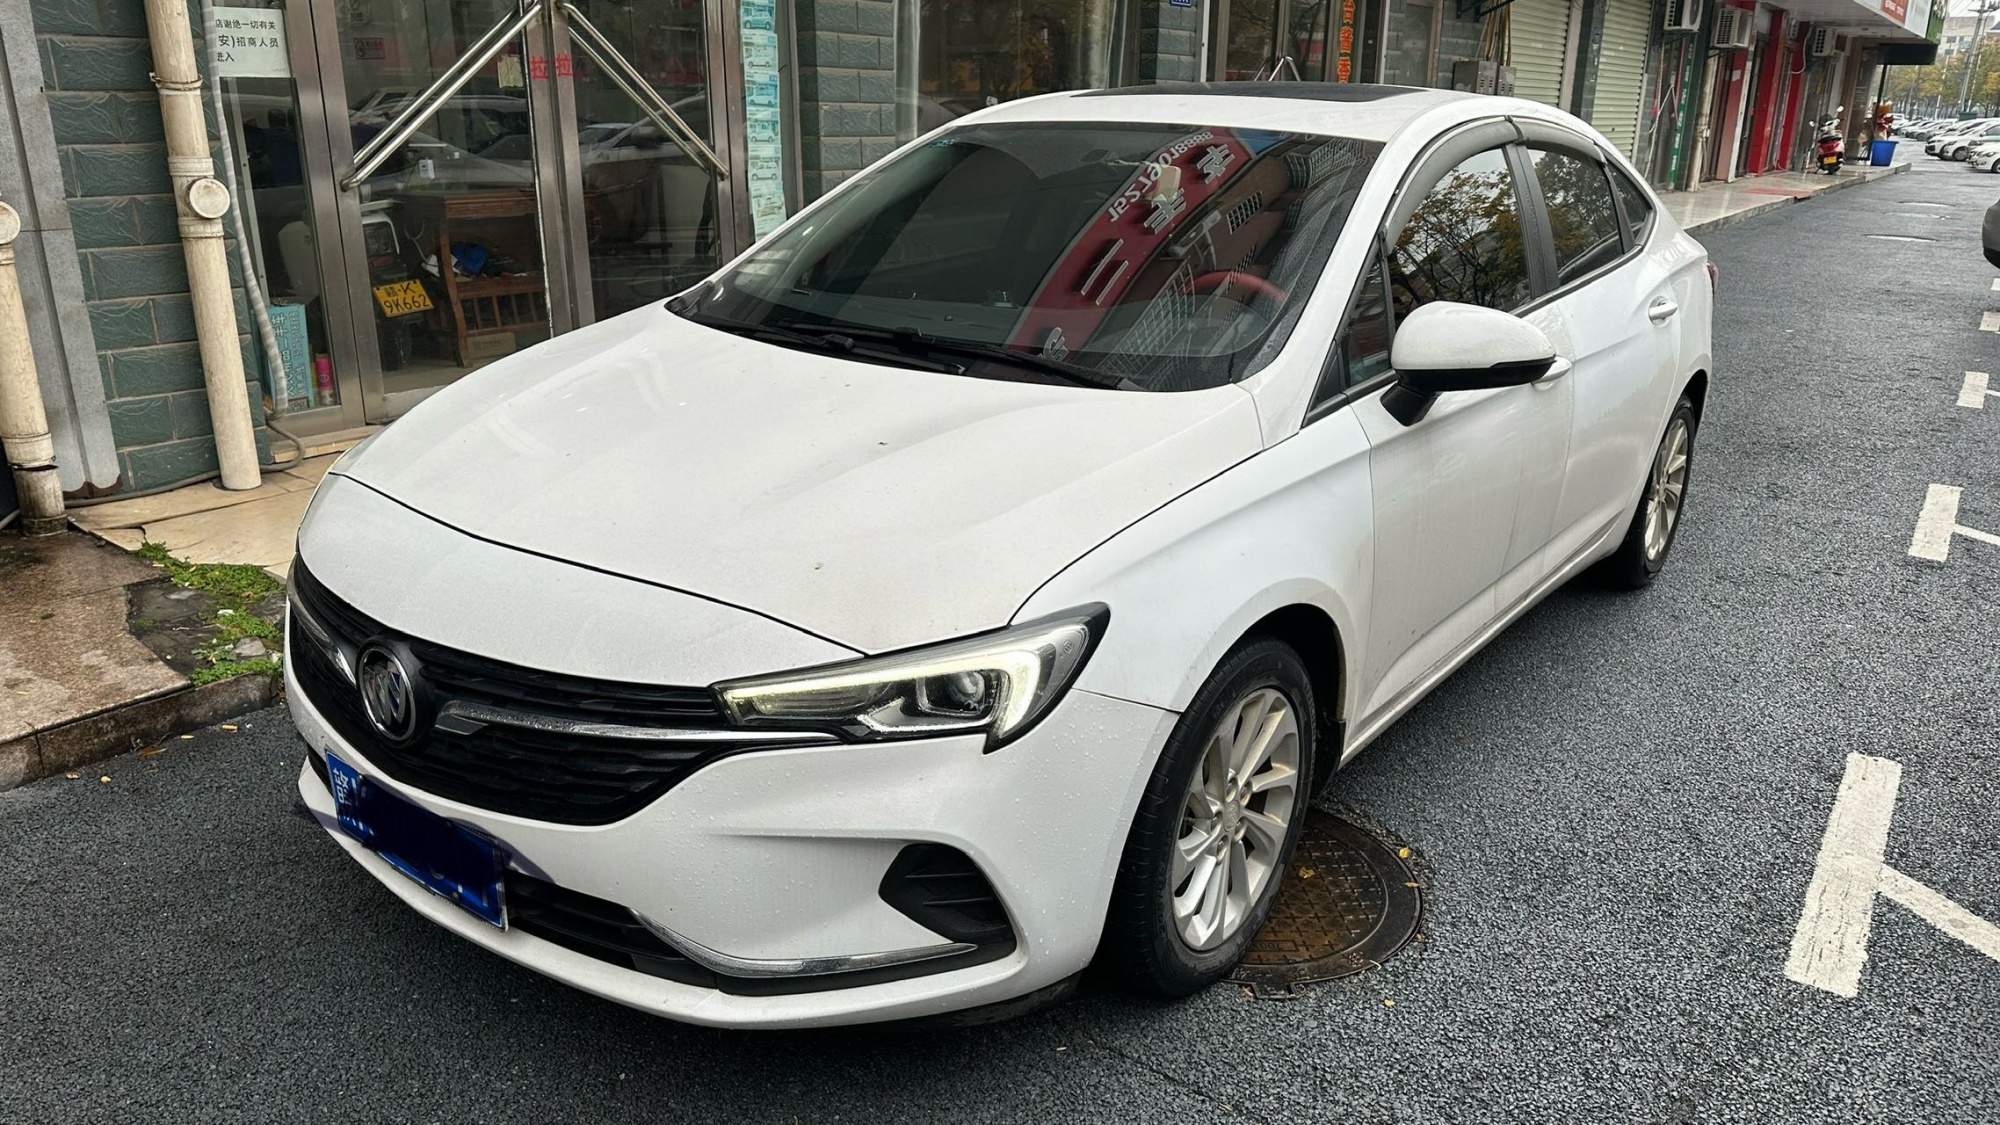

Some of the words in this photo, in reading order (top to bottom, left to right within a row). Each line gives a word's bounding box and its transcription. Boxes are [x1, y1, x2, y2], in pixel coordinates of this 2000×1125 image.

[214, 18, 277, 30] 店谢绝一切有关
[216, 51, 235, 62] 进入
[530, 55, 549, 79] 拉
[555, 53, 574, 77] 拉
[383, 293, 431, 314] 9K662
